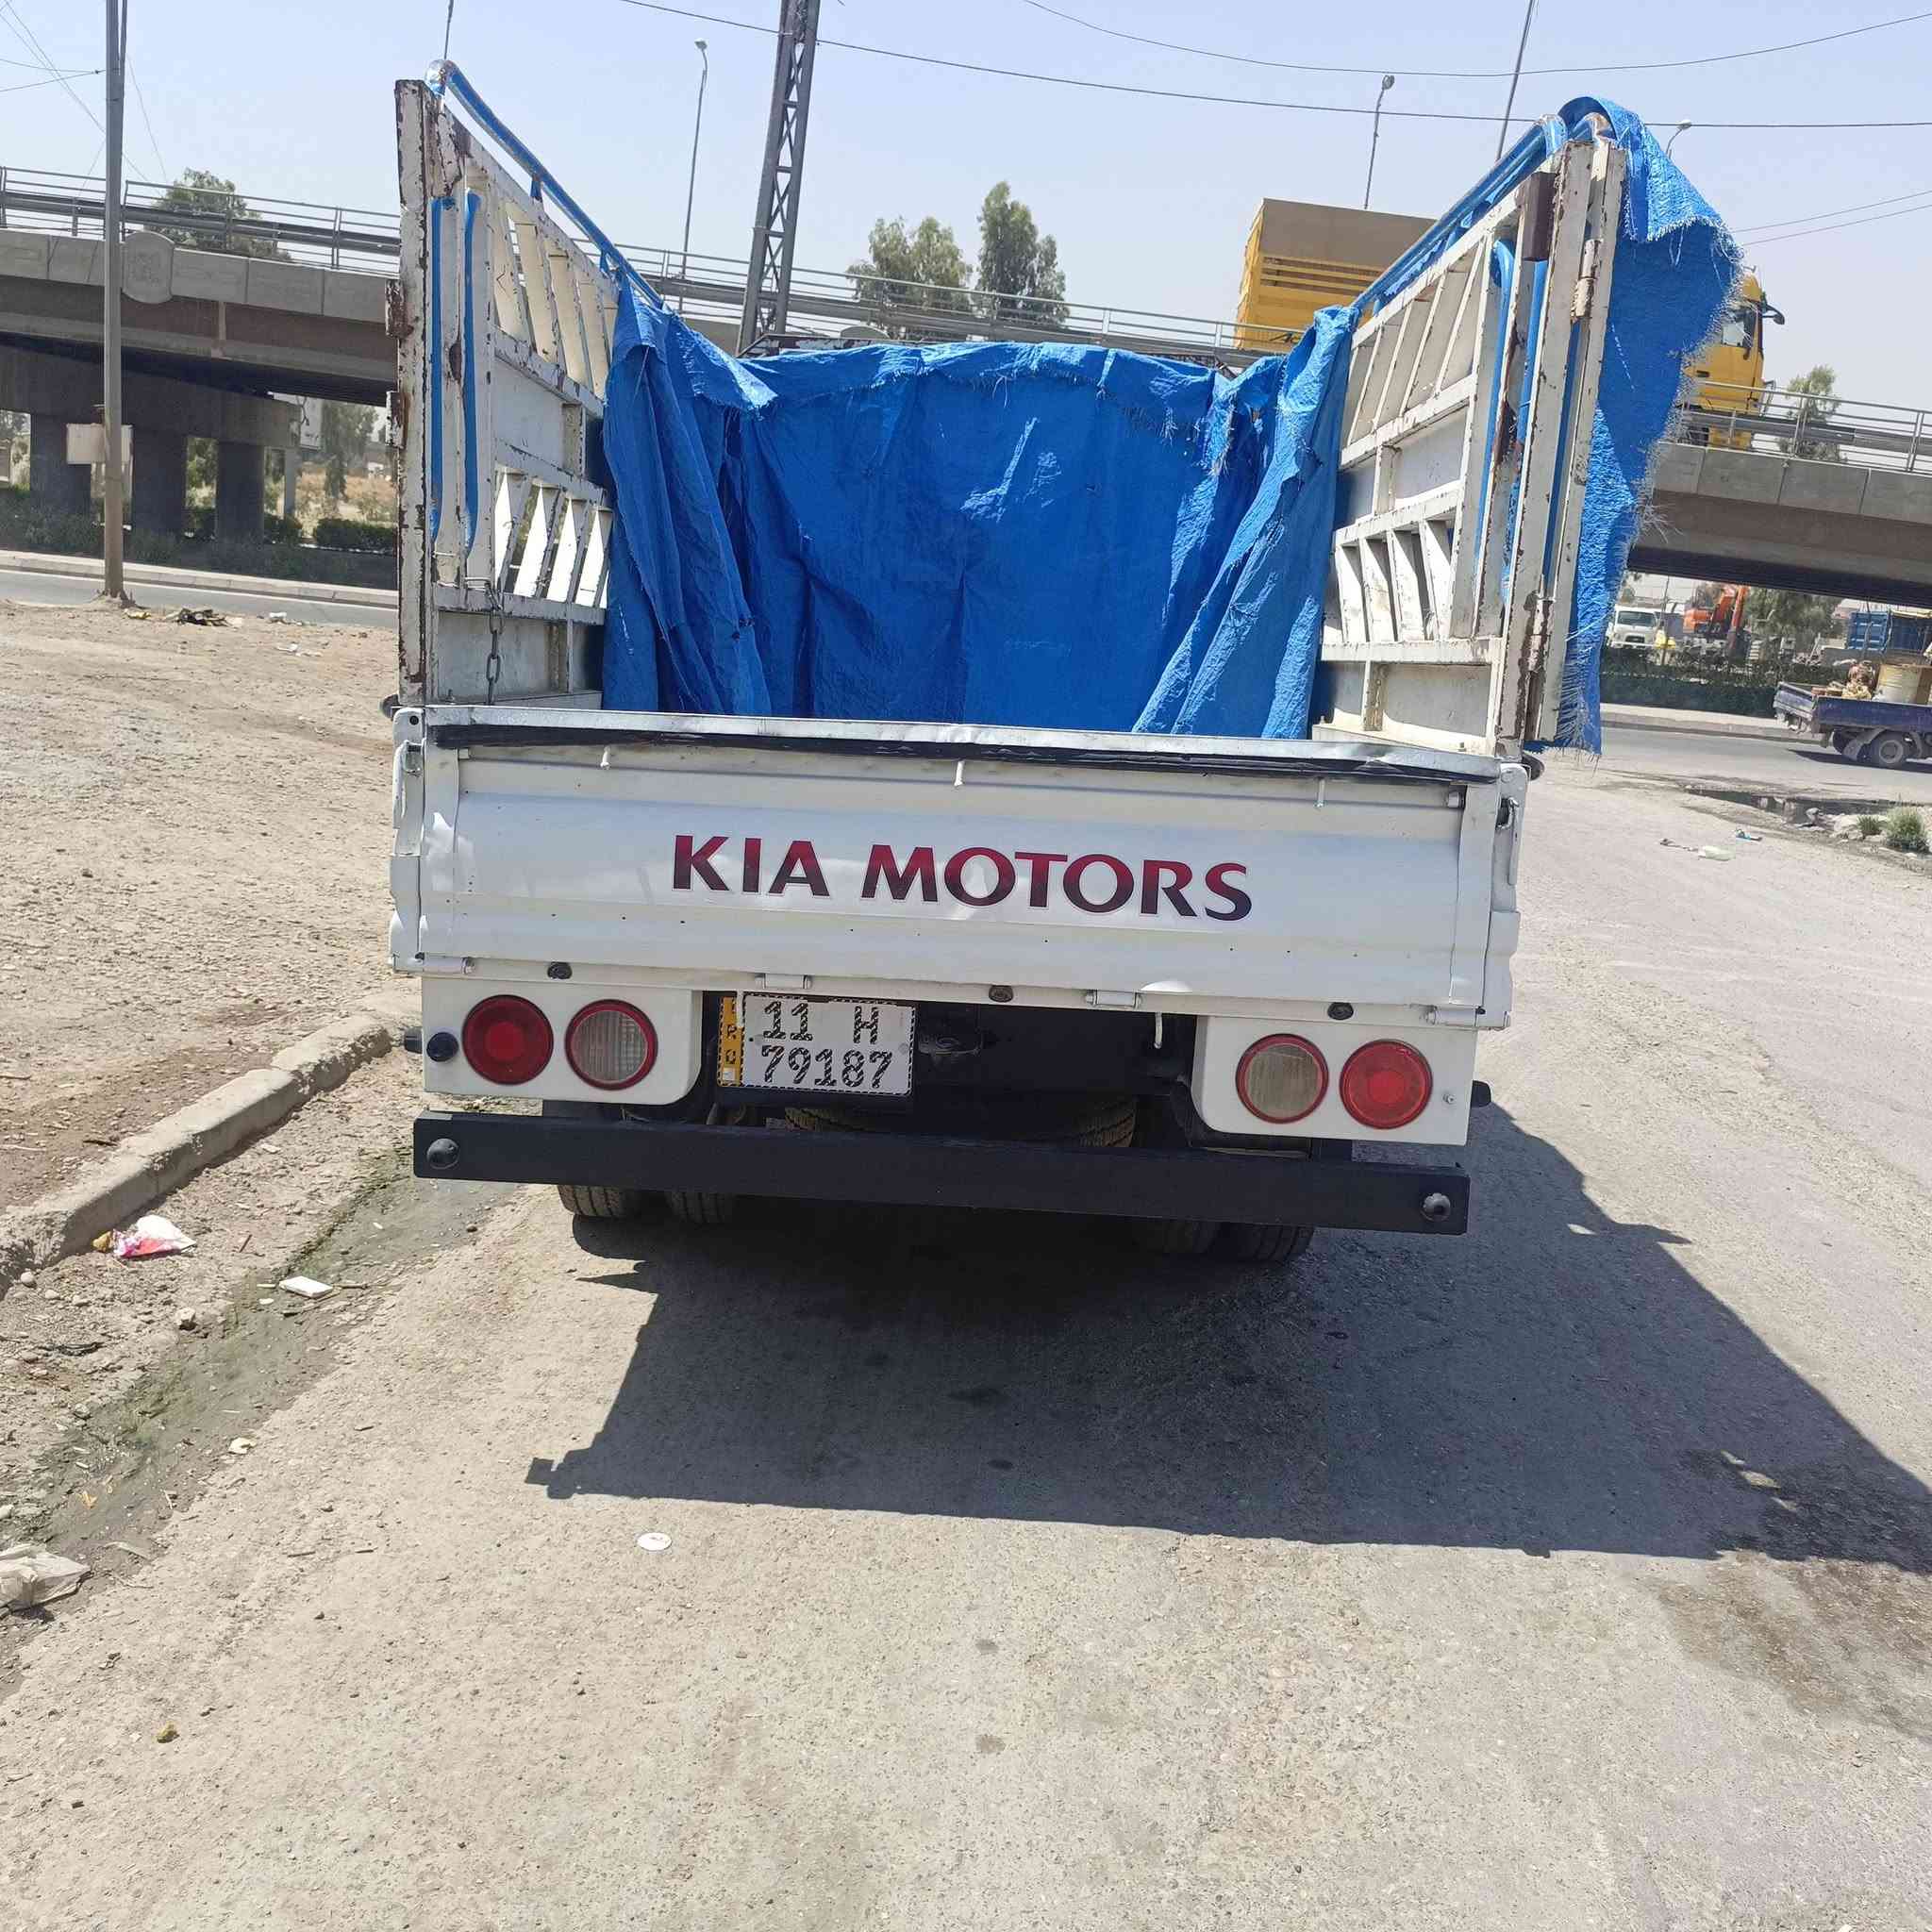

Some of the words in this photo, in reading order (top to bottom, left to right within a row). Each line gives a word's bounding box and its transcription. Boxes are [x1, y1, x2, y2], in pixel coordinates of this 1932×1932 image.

[672, 834, 831, 897] KIA
[860, 843, 1253, 922] MOTORS
[762, 1001, 813, 1041] 11
[853, 1006, 879, 1044] H
[761, 1044, 893, 1089] 79187
